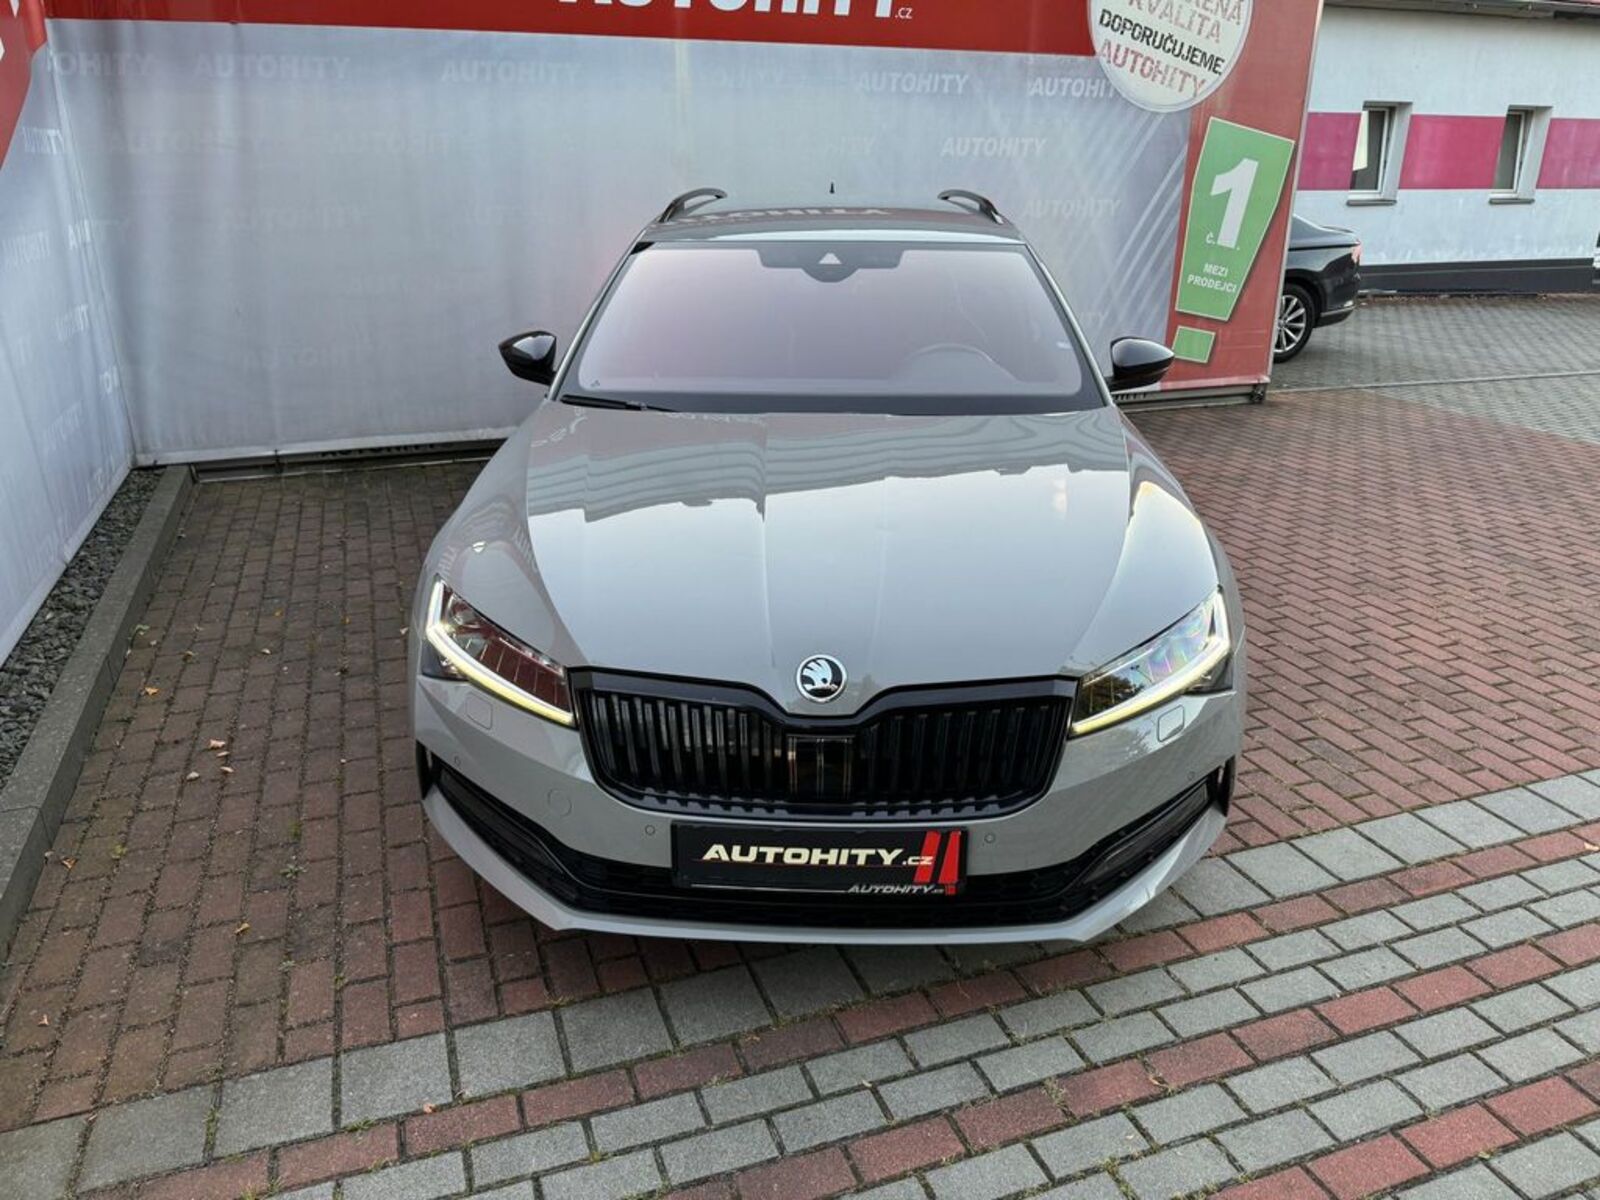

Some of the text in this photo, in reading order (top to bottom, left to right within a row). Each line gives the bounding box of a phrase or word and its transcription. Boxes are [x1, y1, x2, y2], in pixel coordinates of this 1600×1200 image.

[1099, 9, 1226, 76] DOPORUČUJEME
[440, 60, 584, 84] AUTOHITY
[1101, 39, 1206, 99] AUTOHITY
[856, 71, 970, 95] AUTOHITY
[939, 136, 1048, 158] AUTOHITY
[1203, 262, 1229, 277] MEZI
[1187, 274, 1237, 293] PRODEJCI
